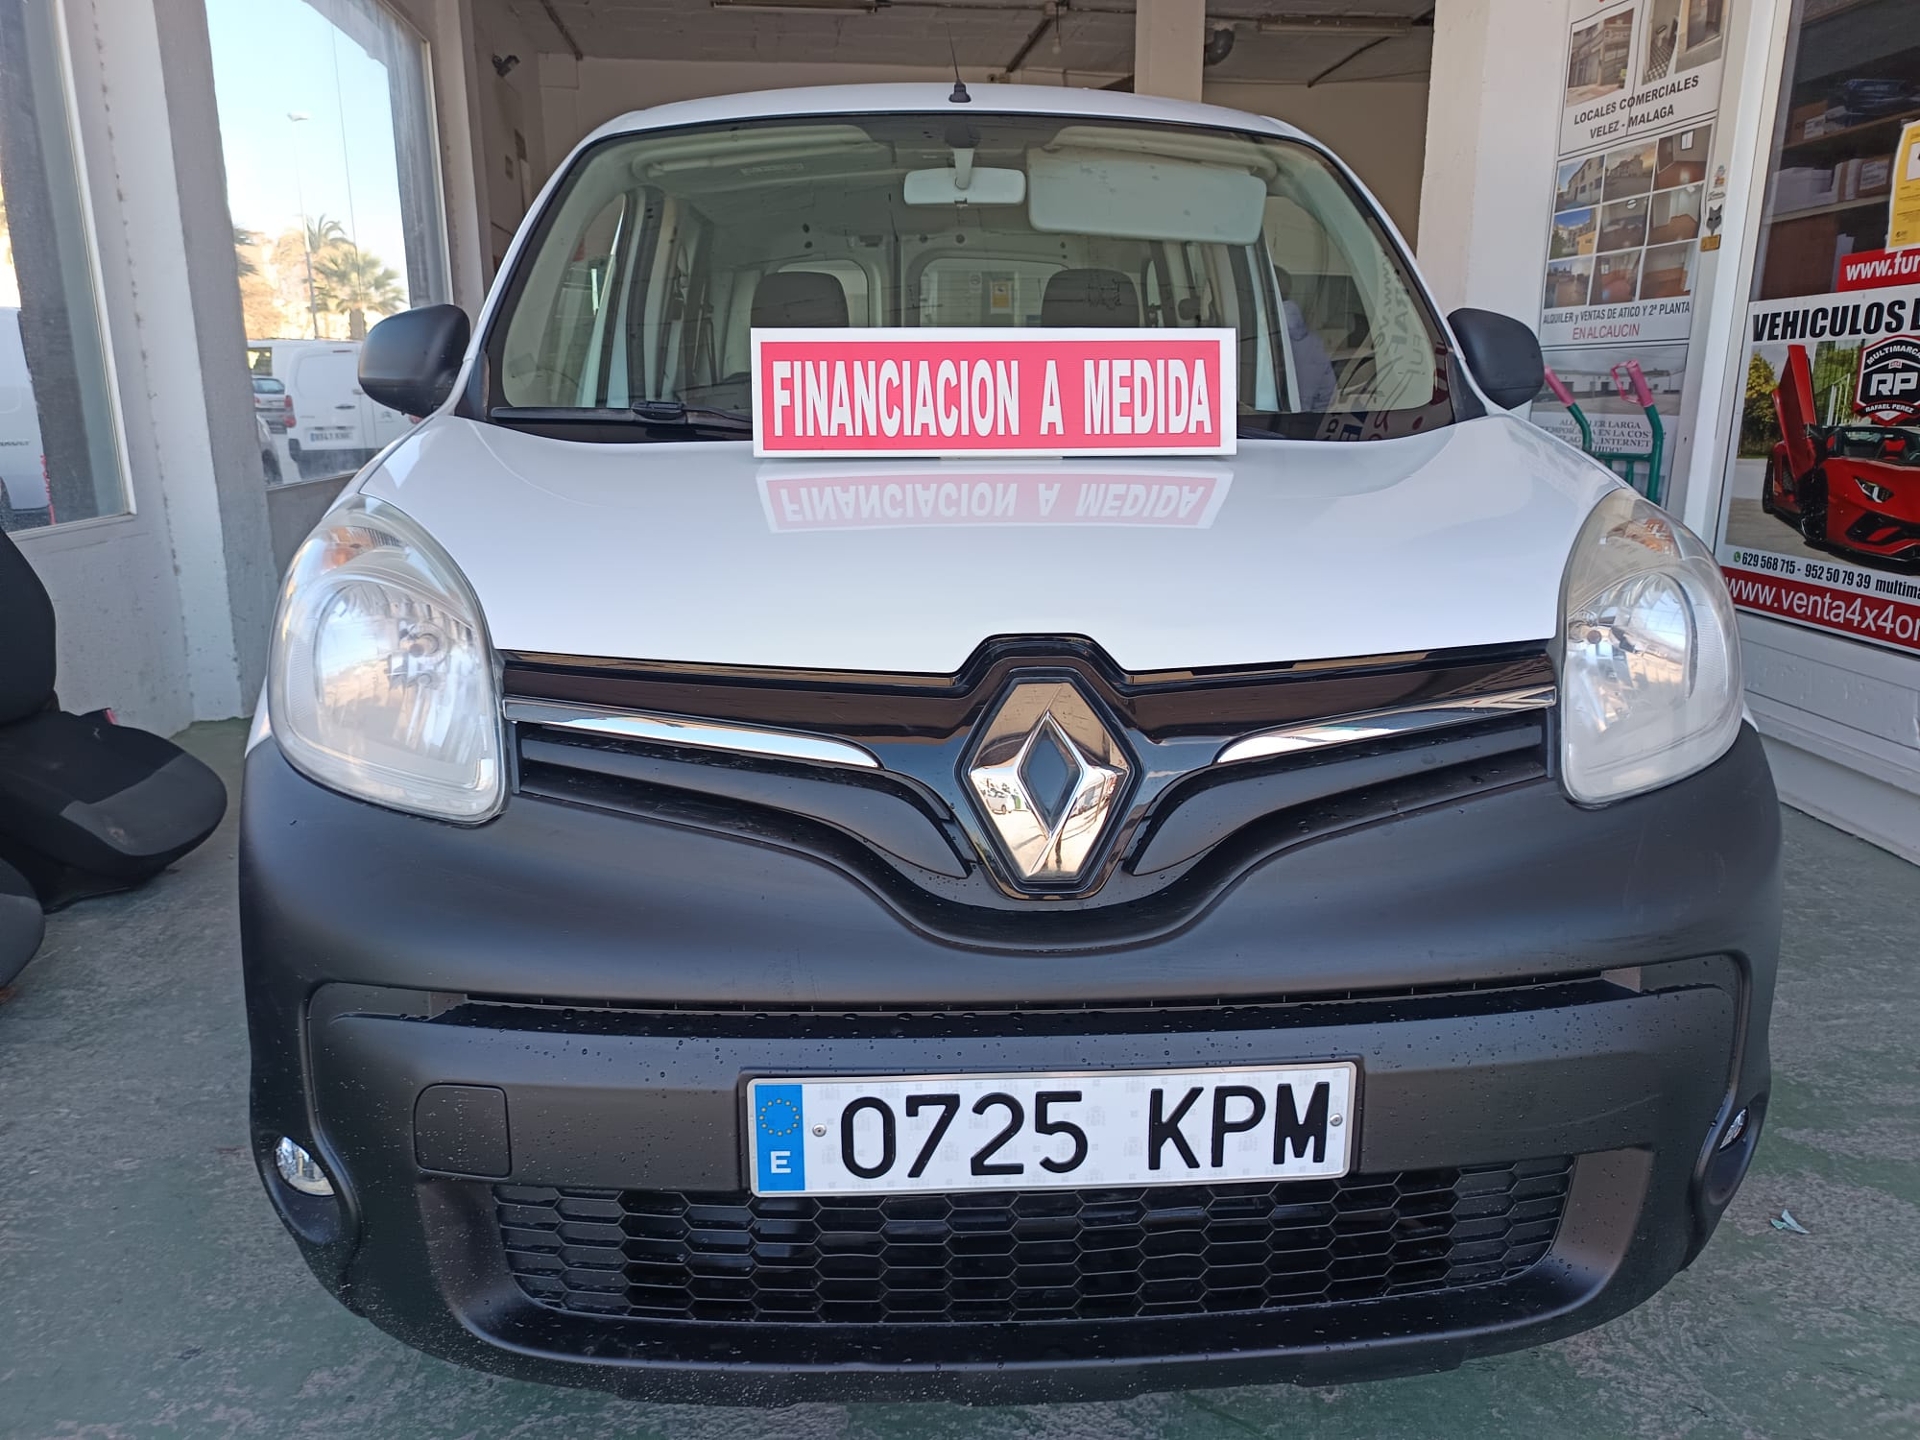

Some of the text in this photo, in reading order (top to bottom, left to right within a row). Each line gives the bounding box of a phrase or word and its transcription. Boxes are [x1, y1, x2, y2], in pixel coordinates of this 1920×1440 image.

[1574, 75, 1699, 125] LOCALES COMERCIALES
[1590, 120, 1620, 139] VELEZ
[1628, 104, 1674, 128] MALAGA
[1543, 312, 1574, 324] ALQUILER
[1580, 308, 1606, 322] VENTAS
[1607, 307, 1617, 319] DE
[1618, 306, 1640, 319] ATICO
[1642, 307, 1648, 316] Y
[1659, 301, 1690, 315] PLANTA
[1752, 300, 1906, 342] VEHICULOS
[1572, 323, 1641, 340] EN ALCAUCIN
[1869, 371, 1919, 396] RP
[772, 359, 1213, 437] FINANCIACION A MEDIDA
[1865, 404, 1914, 414] RAFAEL PEREZ
[1599, 429, 1611, 437] EN
[1608, 421, 1641, 429] LARGA
[1600, 437, 1652, 447] INTERNET
[1741, 552, 1759, 567] 629
[1760, 556, 1778, 571] 568
[1780, 559, 1796, 575] 715
[1804, 563, 1824, 580] 952
[1826, 567, 1840, 583] 50
[1841, 571, 1854, 587] 79
[1856, 574, 1871, 589] 39
[840, 1082, 1331, 1180] 0725 KPM
[770, 1151, 792, 1174] E
